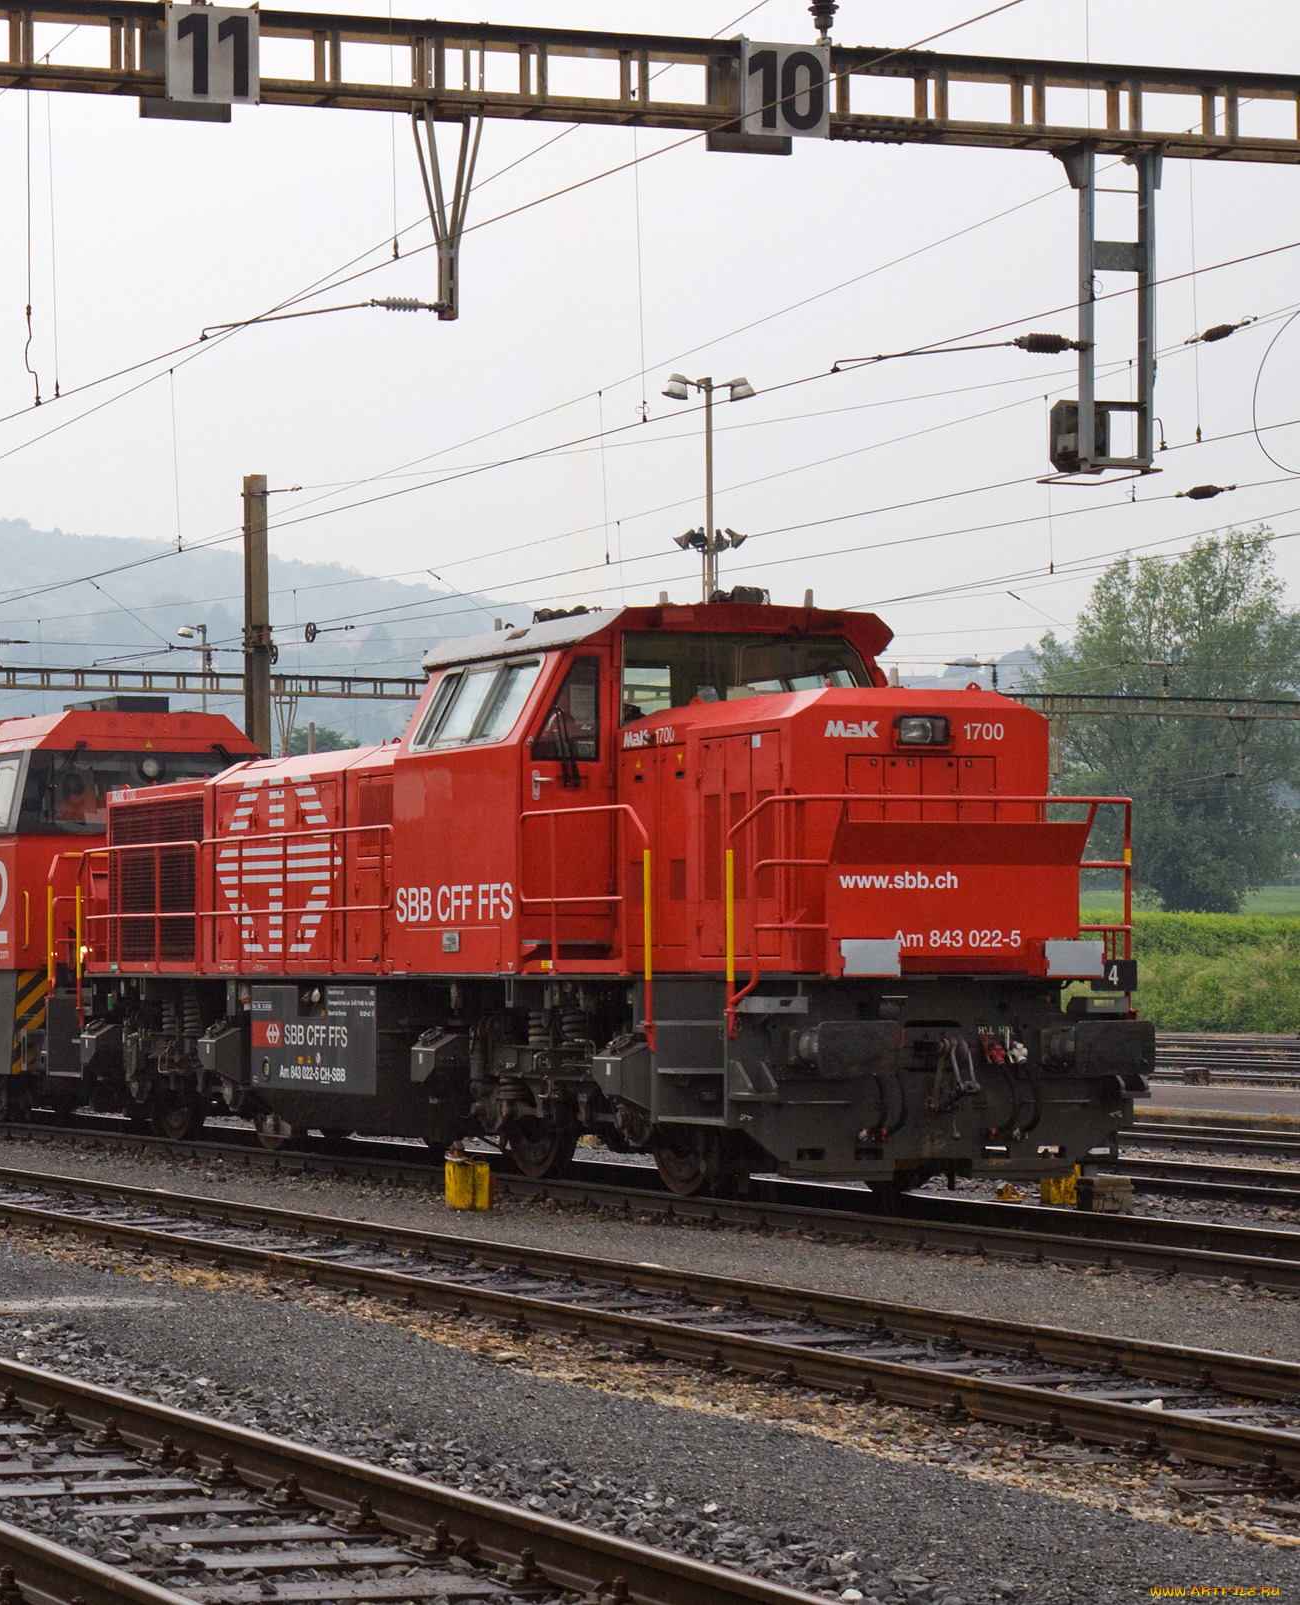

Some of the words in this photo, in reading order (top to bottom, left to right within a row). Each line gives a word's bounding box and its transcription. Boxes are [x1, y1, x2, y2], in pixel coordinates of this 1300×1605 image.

[177, 13, 249, 97] 11
[748, 50, 824, 130] 10
[655, 726, 675, 744] 1700
[824, 720, 879, 738] MaK
[963, 723, 1004, 740] 1700
[839, 871, 958, 889] www.sbb.ch
[396, 887, 432, 923] SBB
[437, 885, 473, 922] CFF
[478, 882, 513, 920] FFS
[894, 930, 923, 947] Am
[929, 930, 963, 947] 843
[969, 930, 1021, 947] 022-5
[1108, 964, 1119, 985] 4
[284, 1024, 305, 1045] SBB
[306, 1025, 327, 1047] CFF
[328, 1026, 348, 1048] FFS
[279, 1064, 290, 1079] Am
[290, 1065, 301, 1079] 843
[302, 1066, 319, 1081] 022-5
[320, 1067, 346, 1083] CH-SBB
